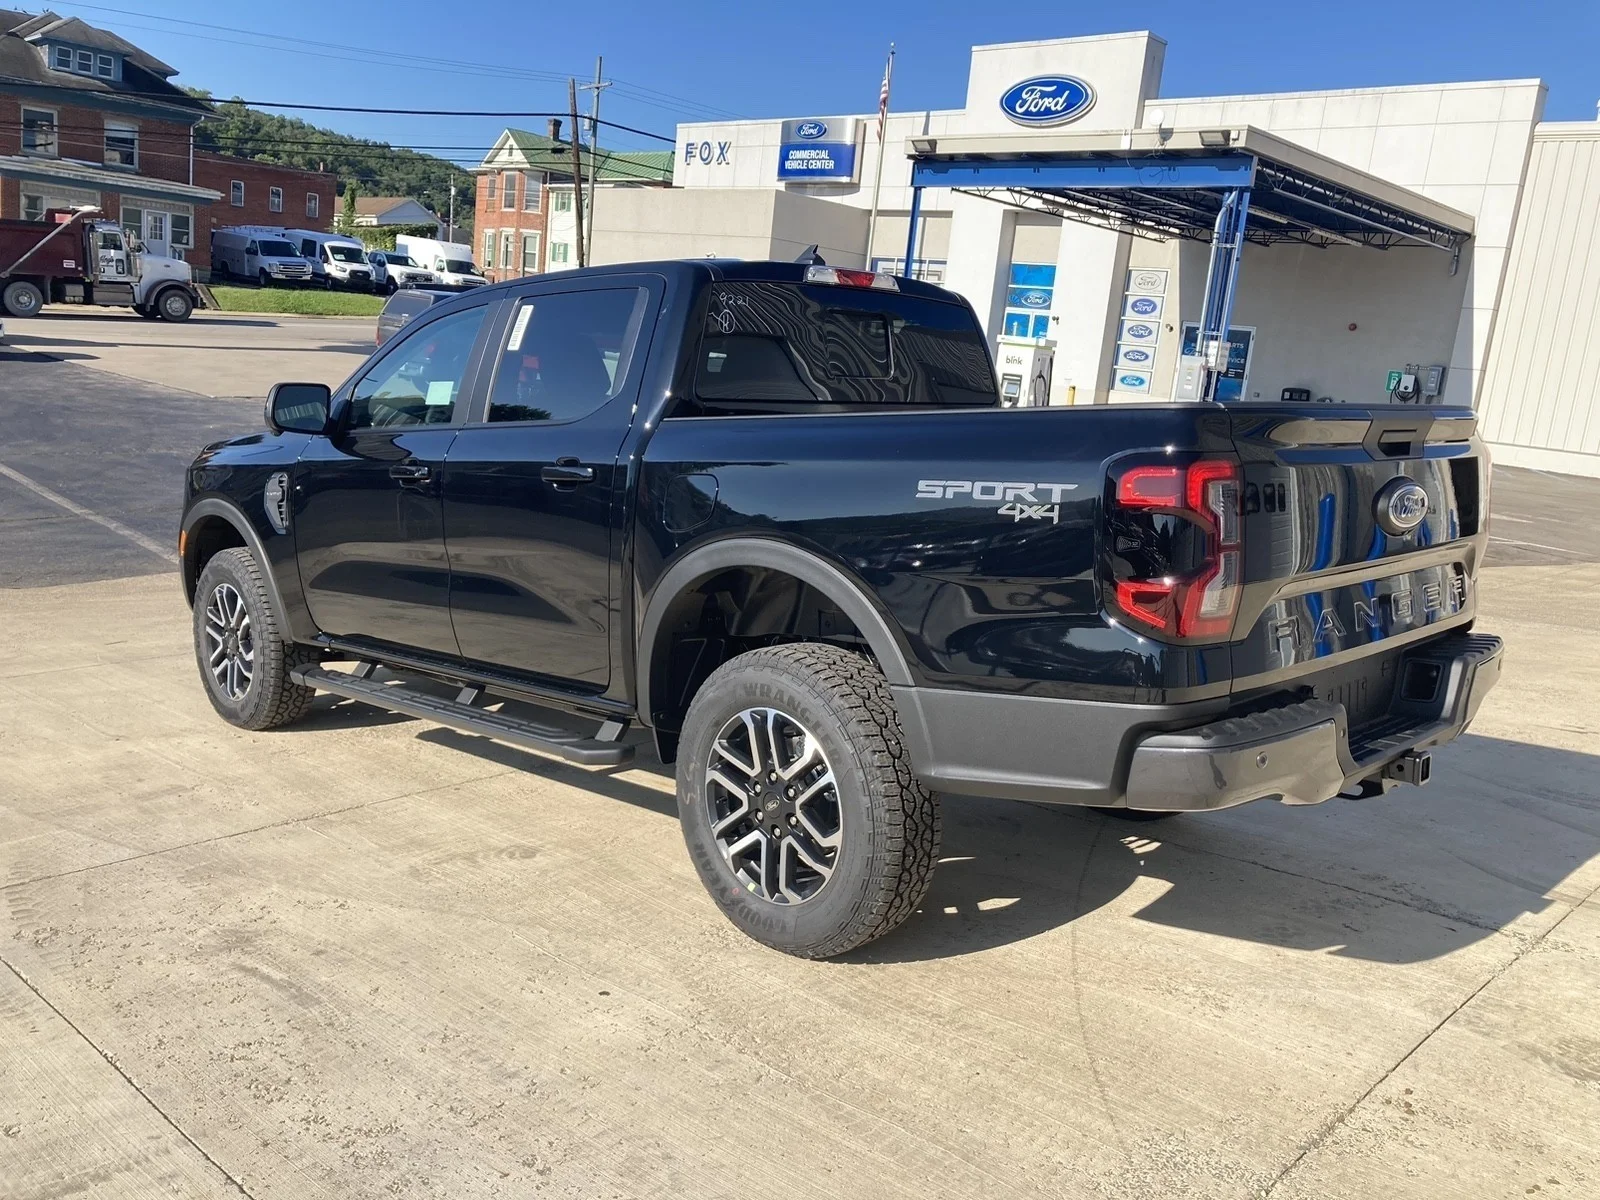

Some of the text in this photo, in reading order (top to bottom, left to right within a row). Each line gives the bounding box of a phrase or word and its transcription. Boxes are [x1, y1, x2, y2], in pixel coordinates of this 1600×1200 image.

[1015, 85, 1070, 113] Ford
[800, 123, 820, 136] Ford
[684, 140, 731, 165] FOX
[788, 149, 830, 160] COMMERCIAL
[784, 159, 835, 170] VEHICLE CENTER
[1138, 275, 1157, 287] Ford
[1134, 301, 1154, 312] Ford
[1129, 325, 1149, 336] Ford
[1126, 350, 1146, 360] Ford
[1005, 356, 1023, 366] blink
[916, 480, 1078, 503] SPORT
[1268, 574, 1466, 653] RANGER
